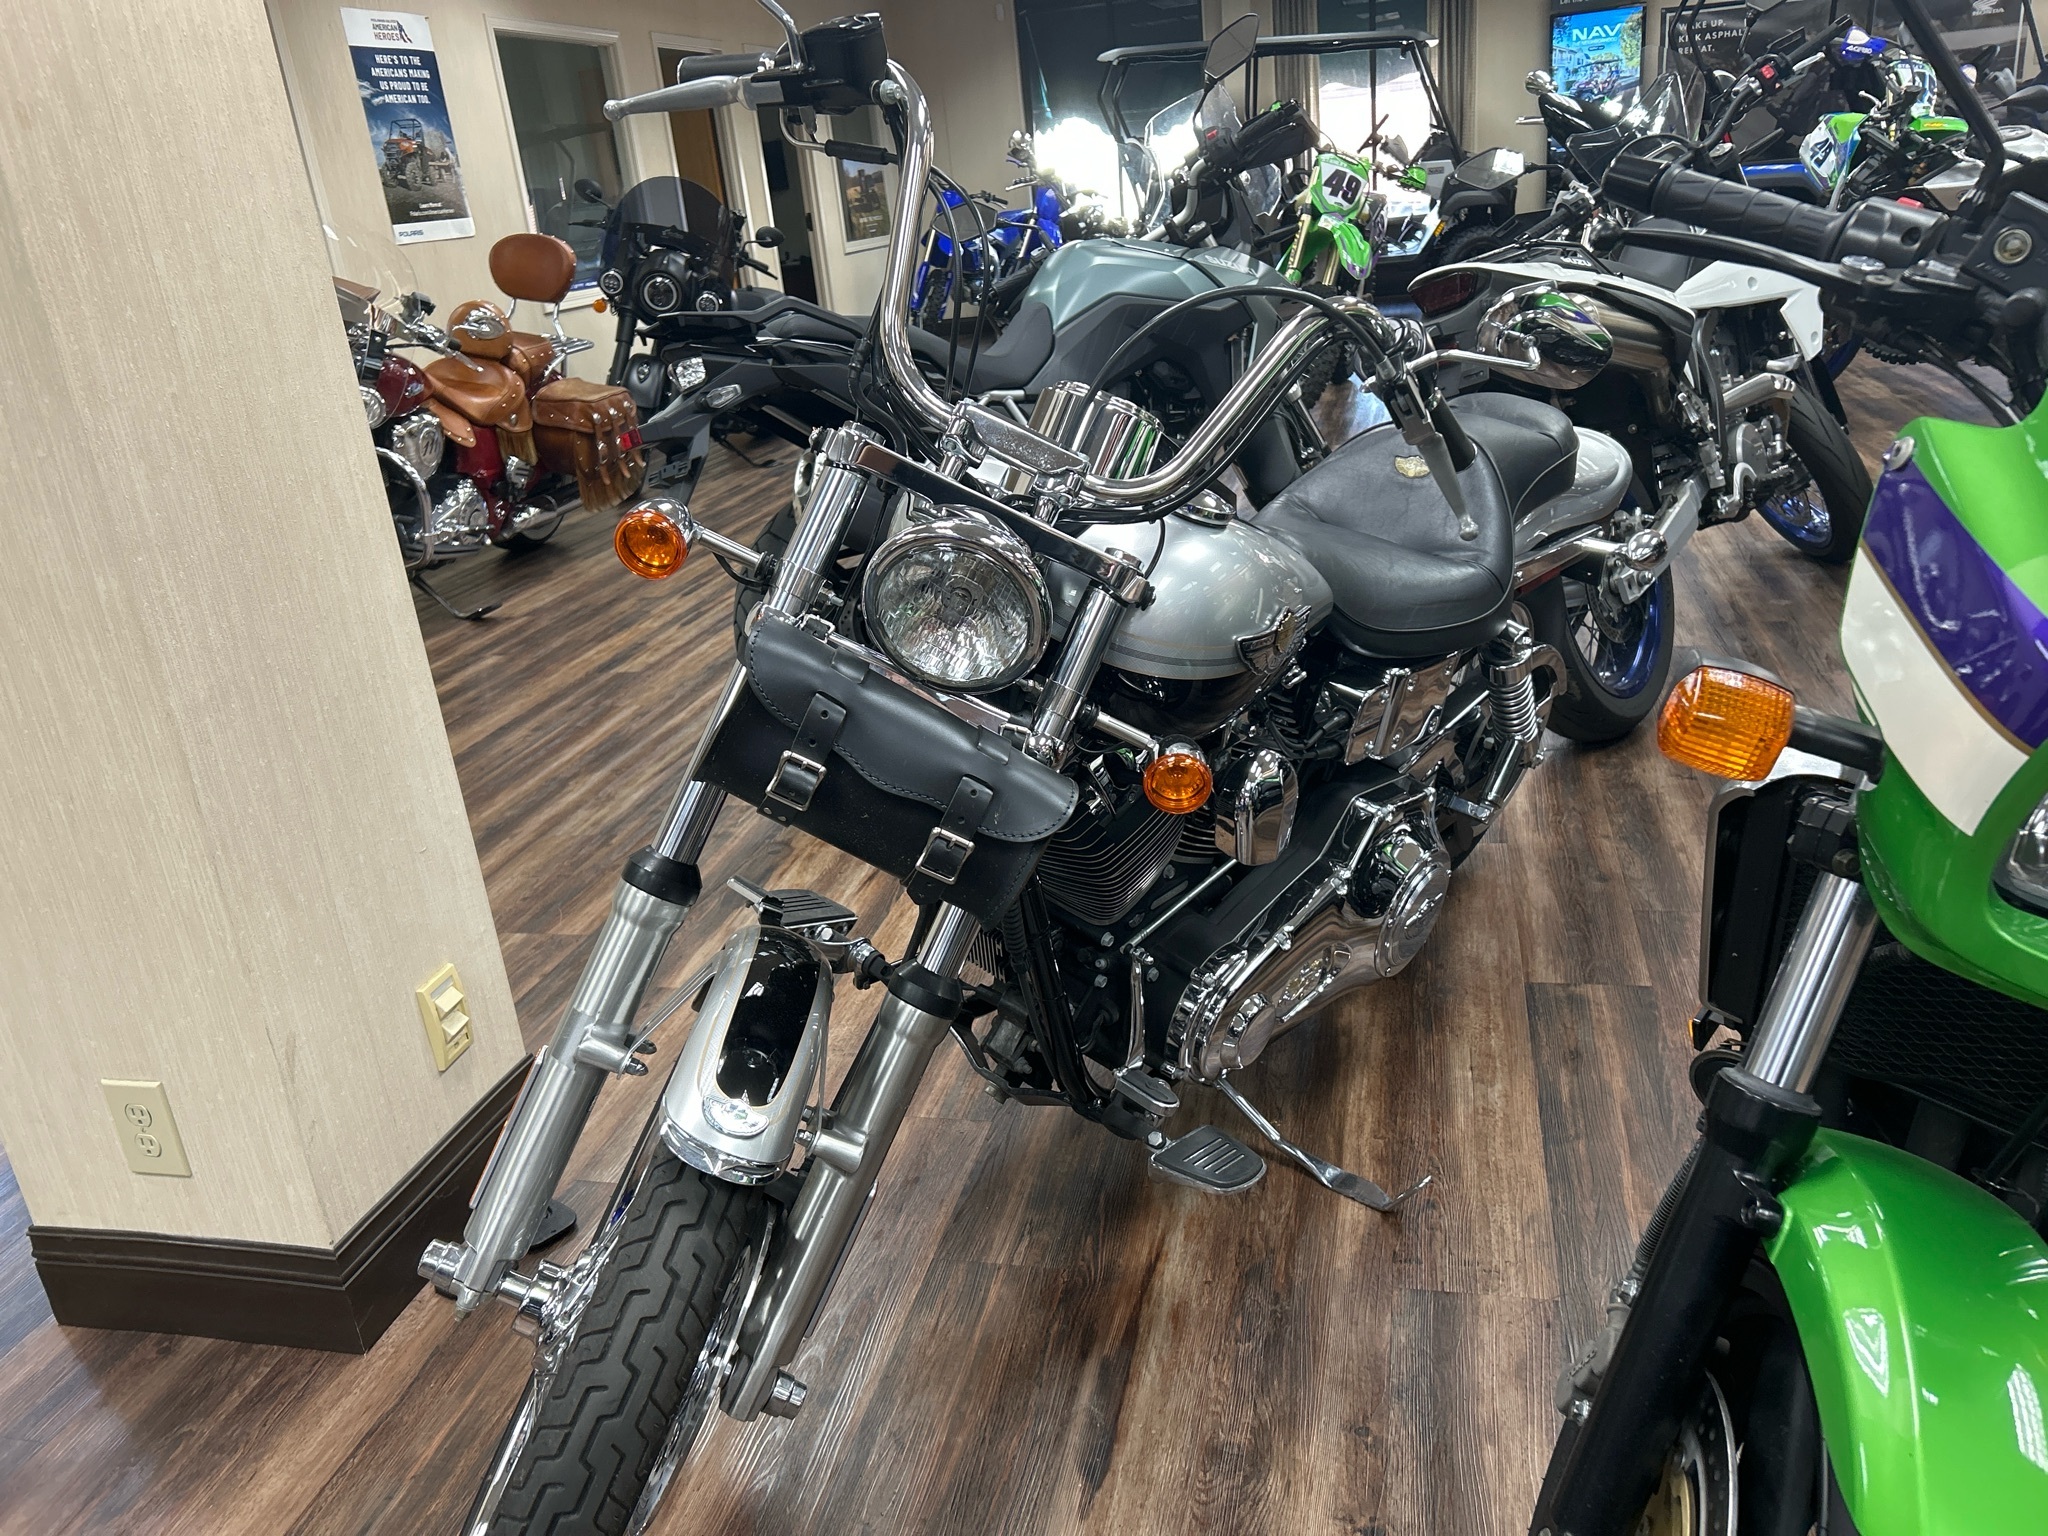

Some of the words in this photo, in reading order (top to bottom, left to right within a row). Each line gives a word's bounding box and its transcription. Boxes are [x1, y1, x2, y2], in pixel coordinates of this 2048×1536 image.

[372, 23, 398, 31] AMERICAN
[1676, 21, 1707, 31] WKE
[1710, 19, 1726, 27] UP.
[374, 32, 400, 41] HEROES
[1572, 23, 1623, 41] NAV
[1678, 33, 1701, 43] KIK
[1704, 28, 1751, 41] ASPHAL.
[1678, 44, 1715, 55] REAT.
[374, 54, 399, 65] HERE'S
[399, 55, 409, 65] TO
[409, 56, 421, 66] THE
[371, 67, 408, 78] AMERICANS
[408, 68, 431, 79] MAKING
[379, 80, 389, 91] US
[389, 81, 412, 91] PROUD
[412, 81, 421, 91] TO
[421, 82, 429, 92] BE
[384, 94, 417, 104] AMERICAN
[417, 94, 431, 104] TOO.
[1323, 168, 1362, 206] 49
[398, 229, 424, 237] POLARIS
[1205, 254, 1260, 279] SUZUKI
